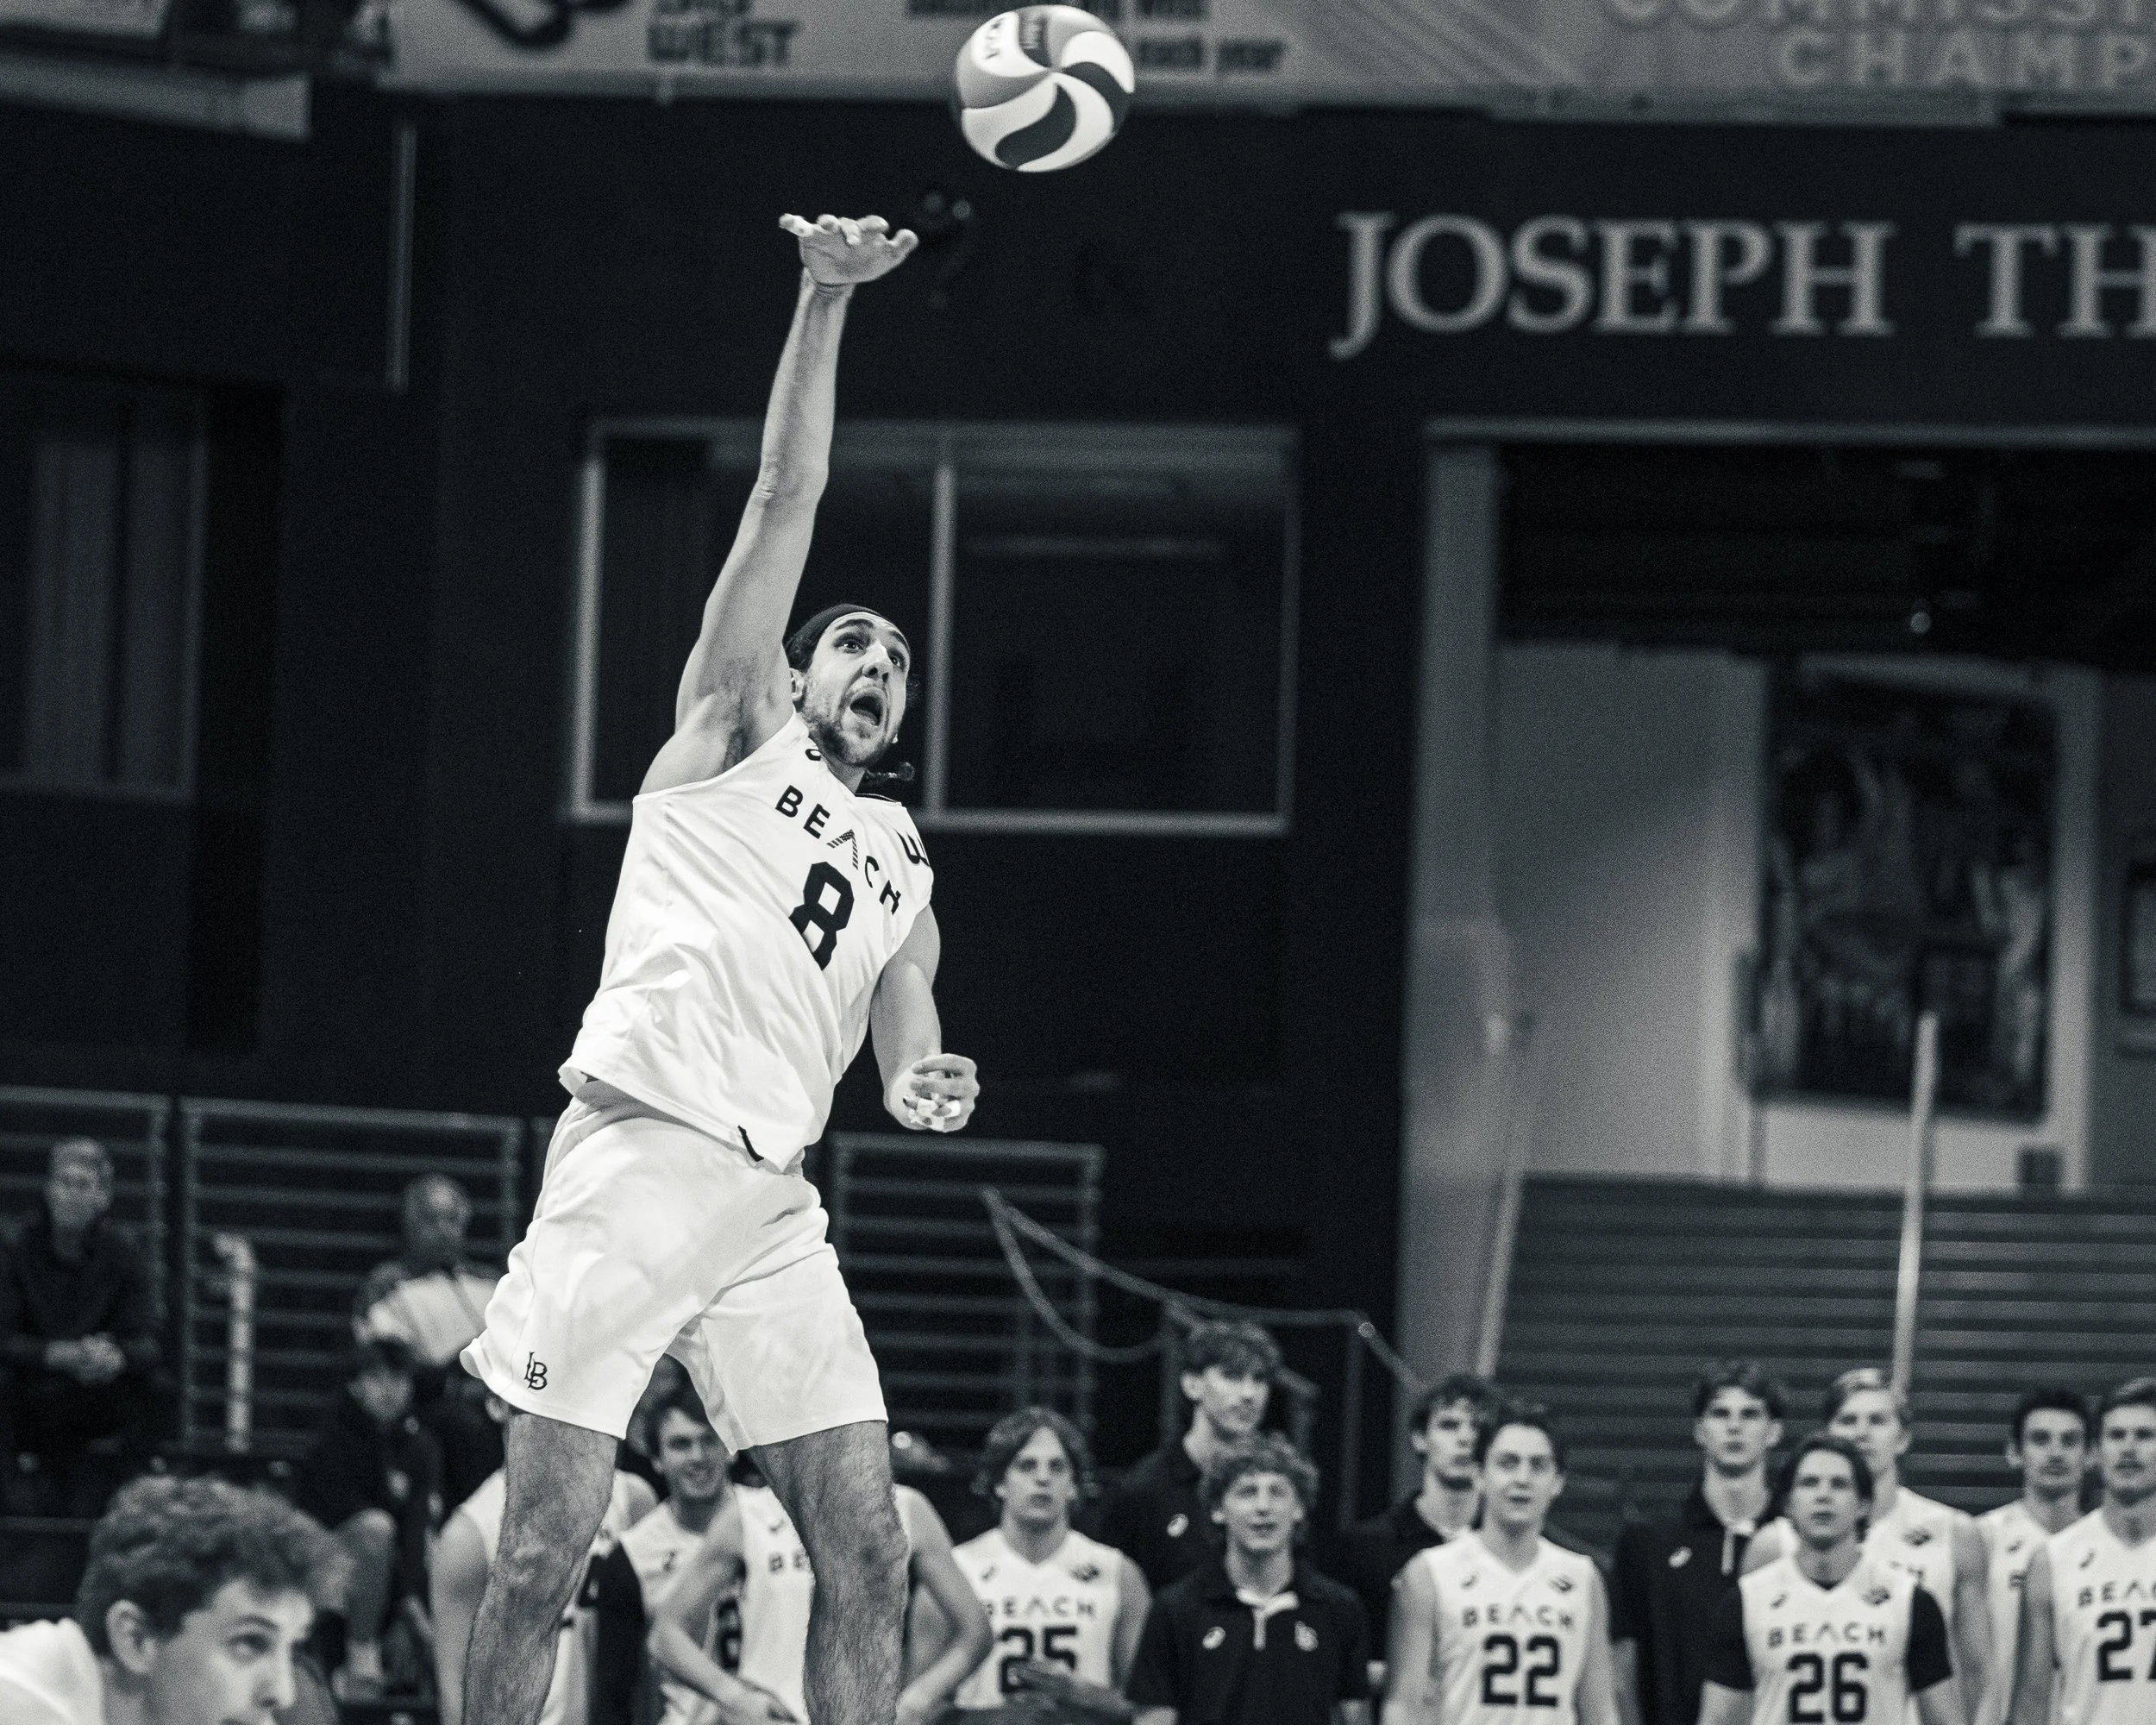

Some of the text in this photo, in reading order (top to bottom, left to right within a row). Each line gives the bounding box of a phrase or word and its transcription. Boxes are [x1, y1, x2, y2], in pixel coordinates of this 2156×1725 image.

[1776, 31, 2149, 86] CHAMP
[1330, 212, 2156, 358] JOSEPH TH
[775, 785, 901, 915] BEACH
[789, 862, 855, 971] 8
[1463, 1603, 1575, 1629] BEACH
[2078, 1580, 2156, 1608] BEA
[1000, 1626, 1077, 1693] 25
[1768, 1622, 1886, 1648] BEACH
[1482, 1633, 1559, 1707] 22
[1788, 1653, 1868, 1723] 26
